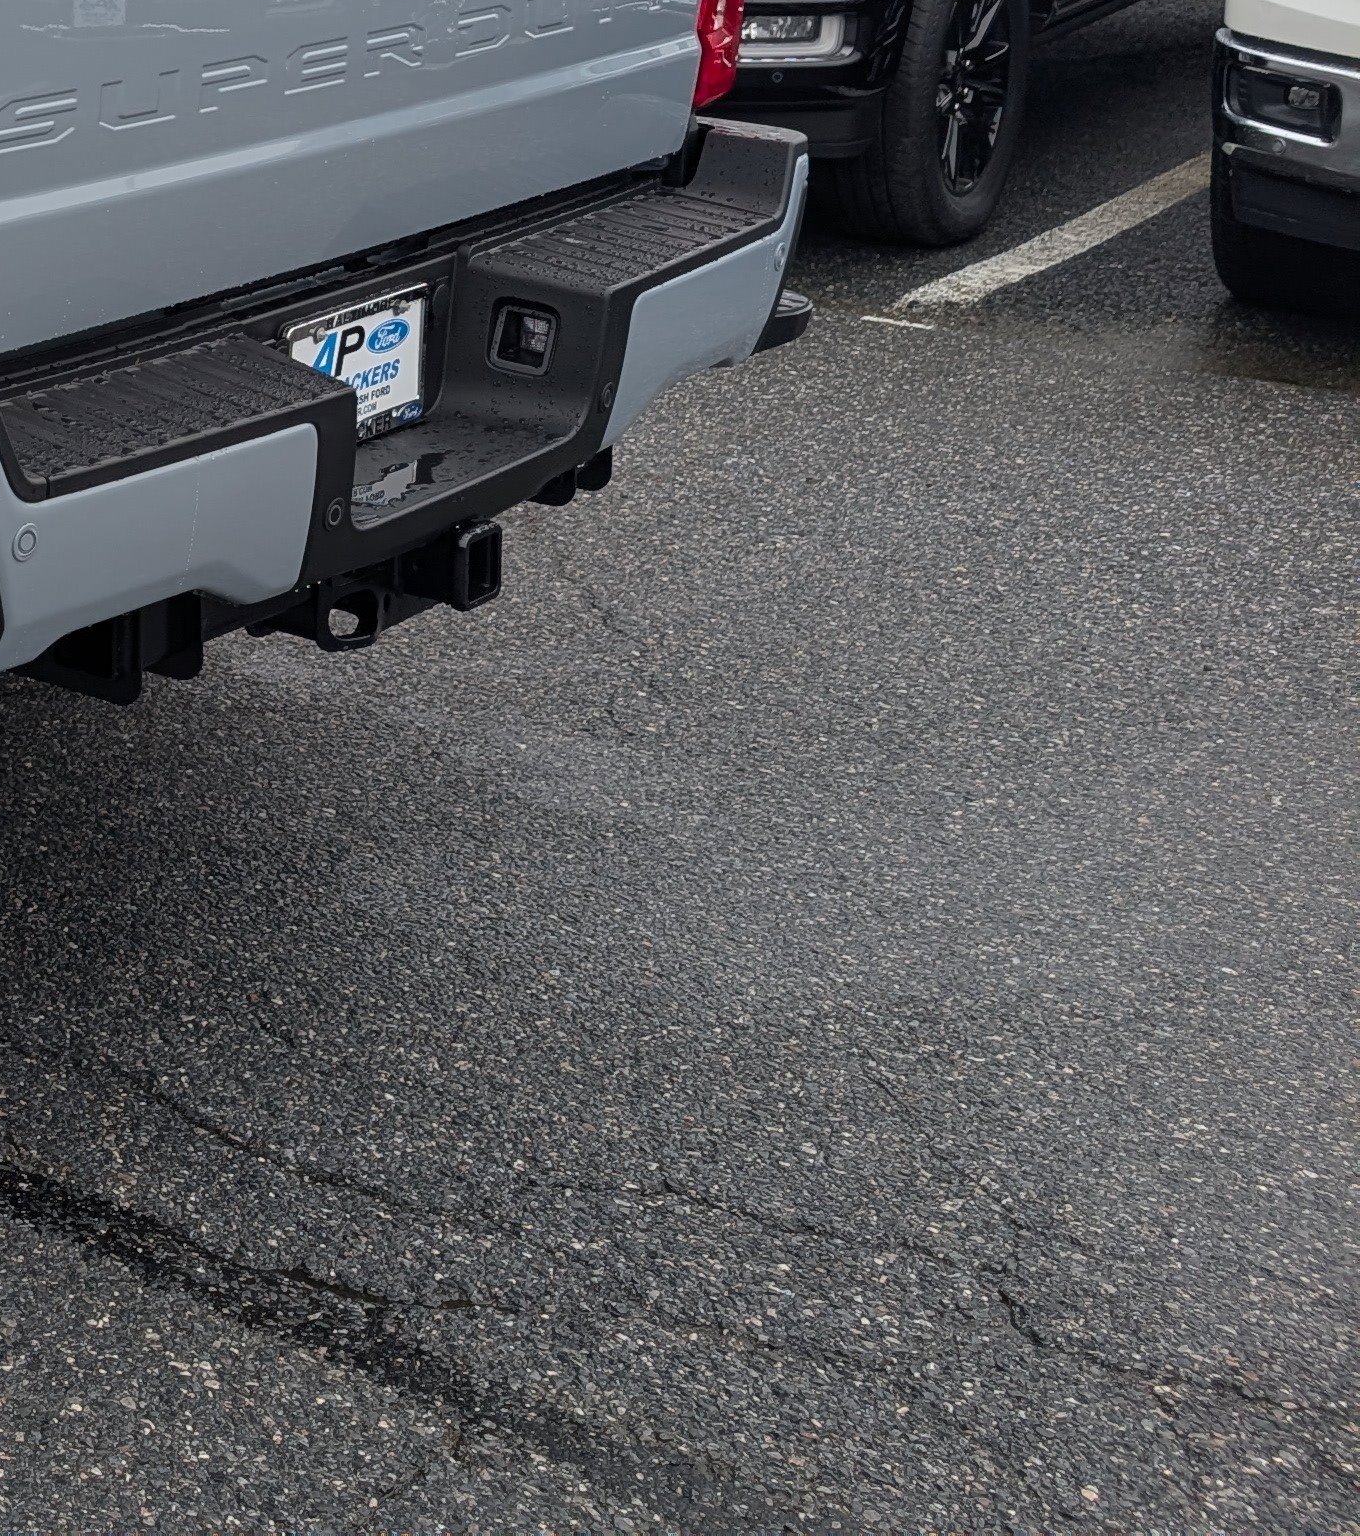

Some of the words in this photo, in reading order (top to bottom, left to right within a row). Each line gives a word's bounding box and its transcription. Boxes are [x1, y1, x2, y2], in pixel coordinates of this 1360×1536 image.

[372, 322, 405, 351] Ford
[371, 384, 391, 400] FORD
[401, 404, 421, 422] Ford
